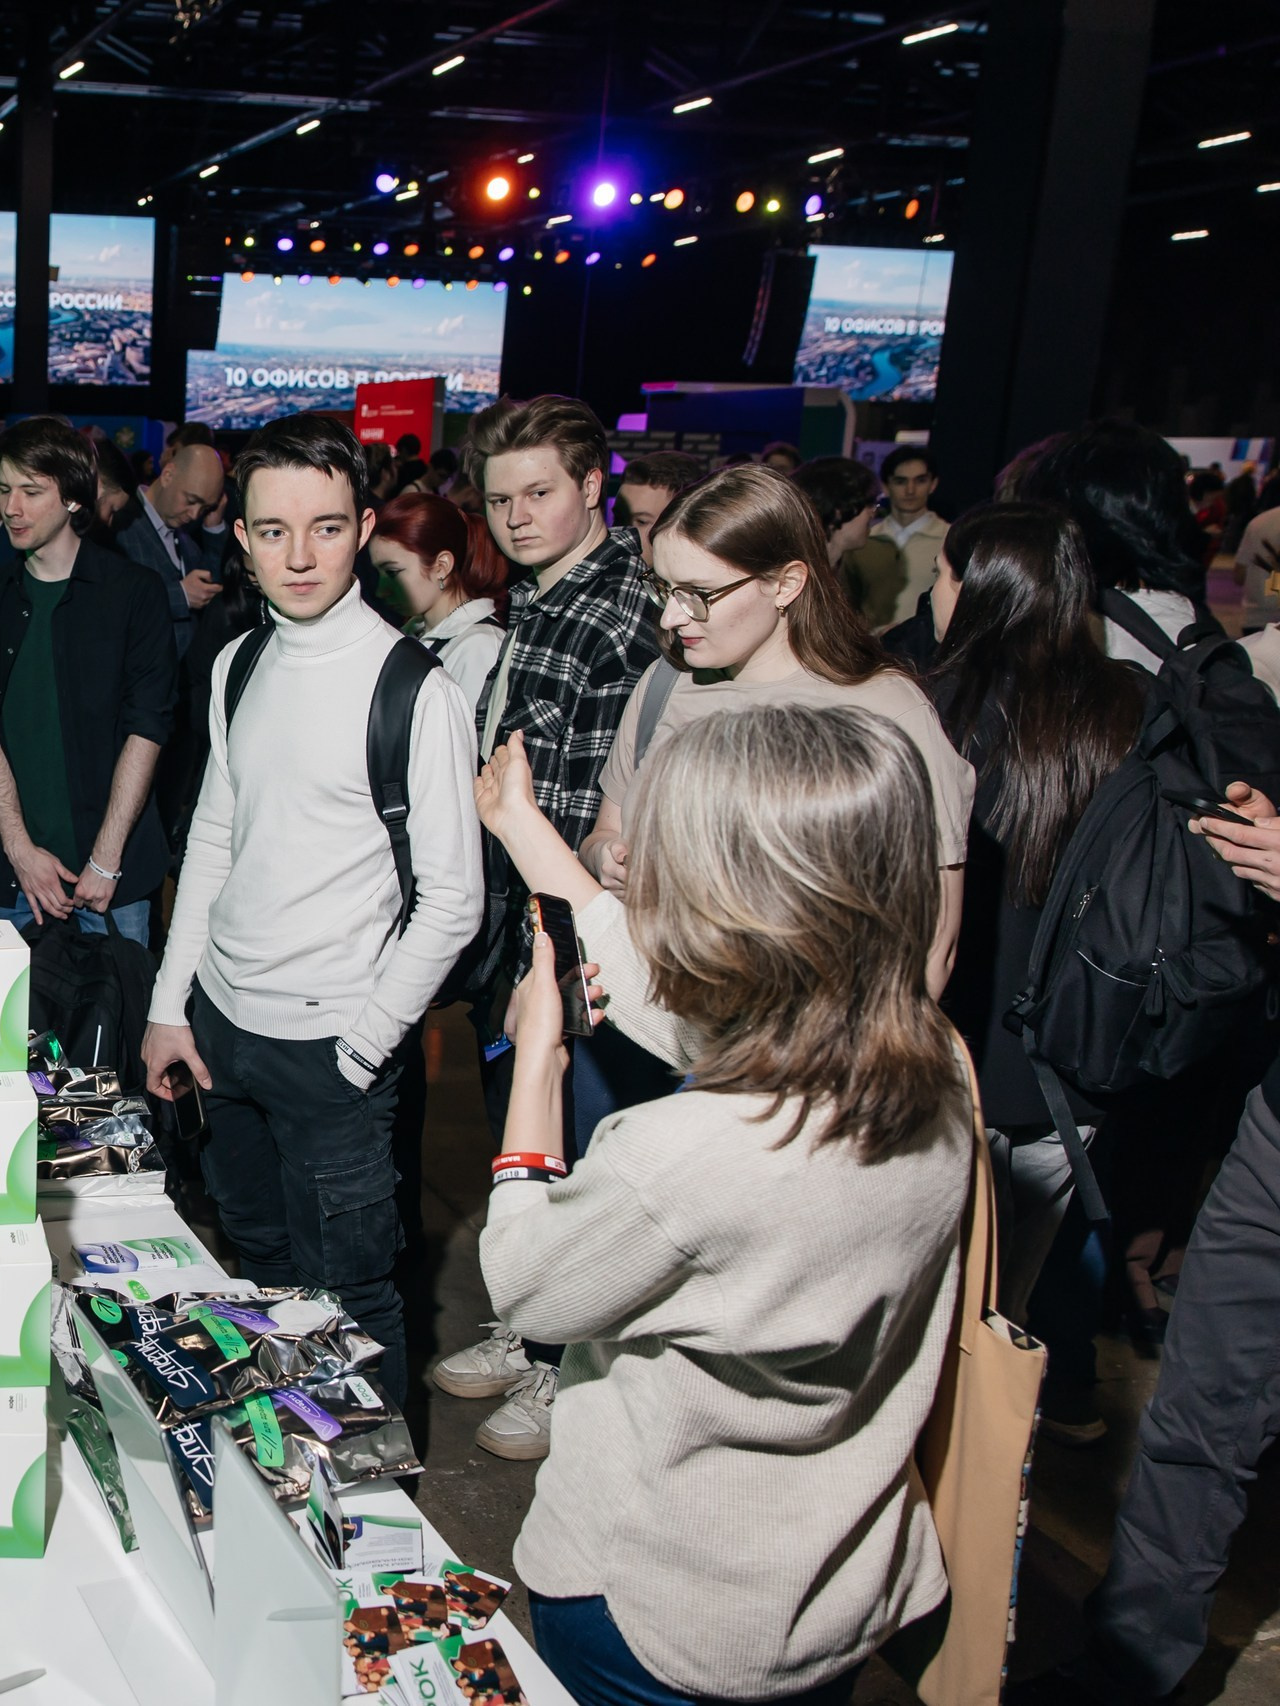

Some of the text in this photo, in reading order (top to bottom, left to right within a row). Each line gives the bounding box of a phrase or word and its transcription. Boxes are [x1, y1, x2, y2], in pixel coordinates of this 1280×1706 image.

[49, 292, 122, 311] РОССИИ
[224, 367, 247, 387] 10
[251, 367, 350, 389] ОФИСОВ
[354, 1382, 375, 1403] КРОК
[288, 1394, 311, 1414] старта
